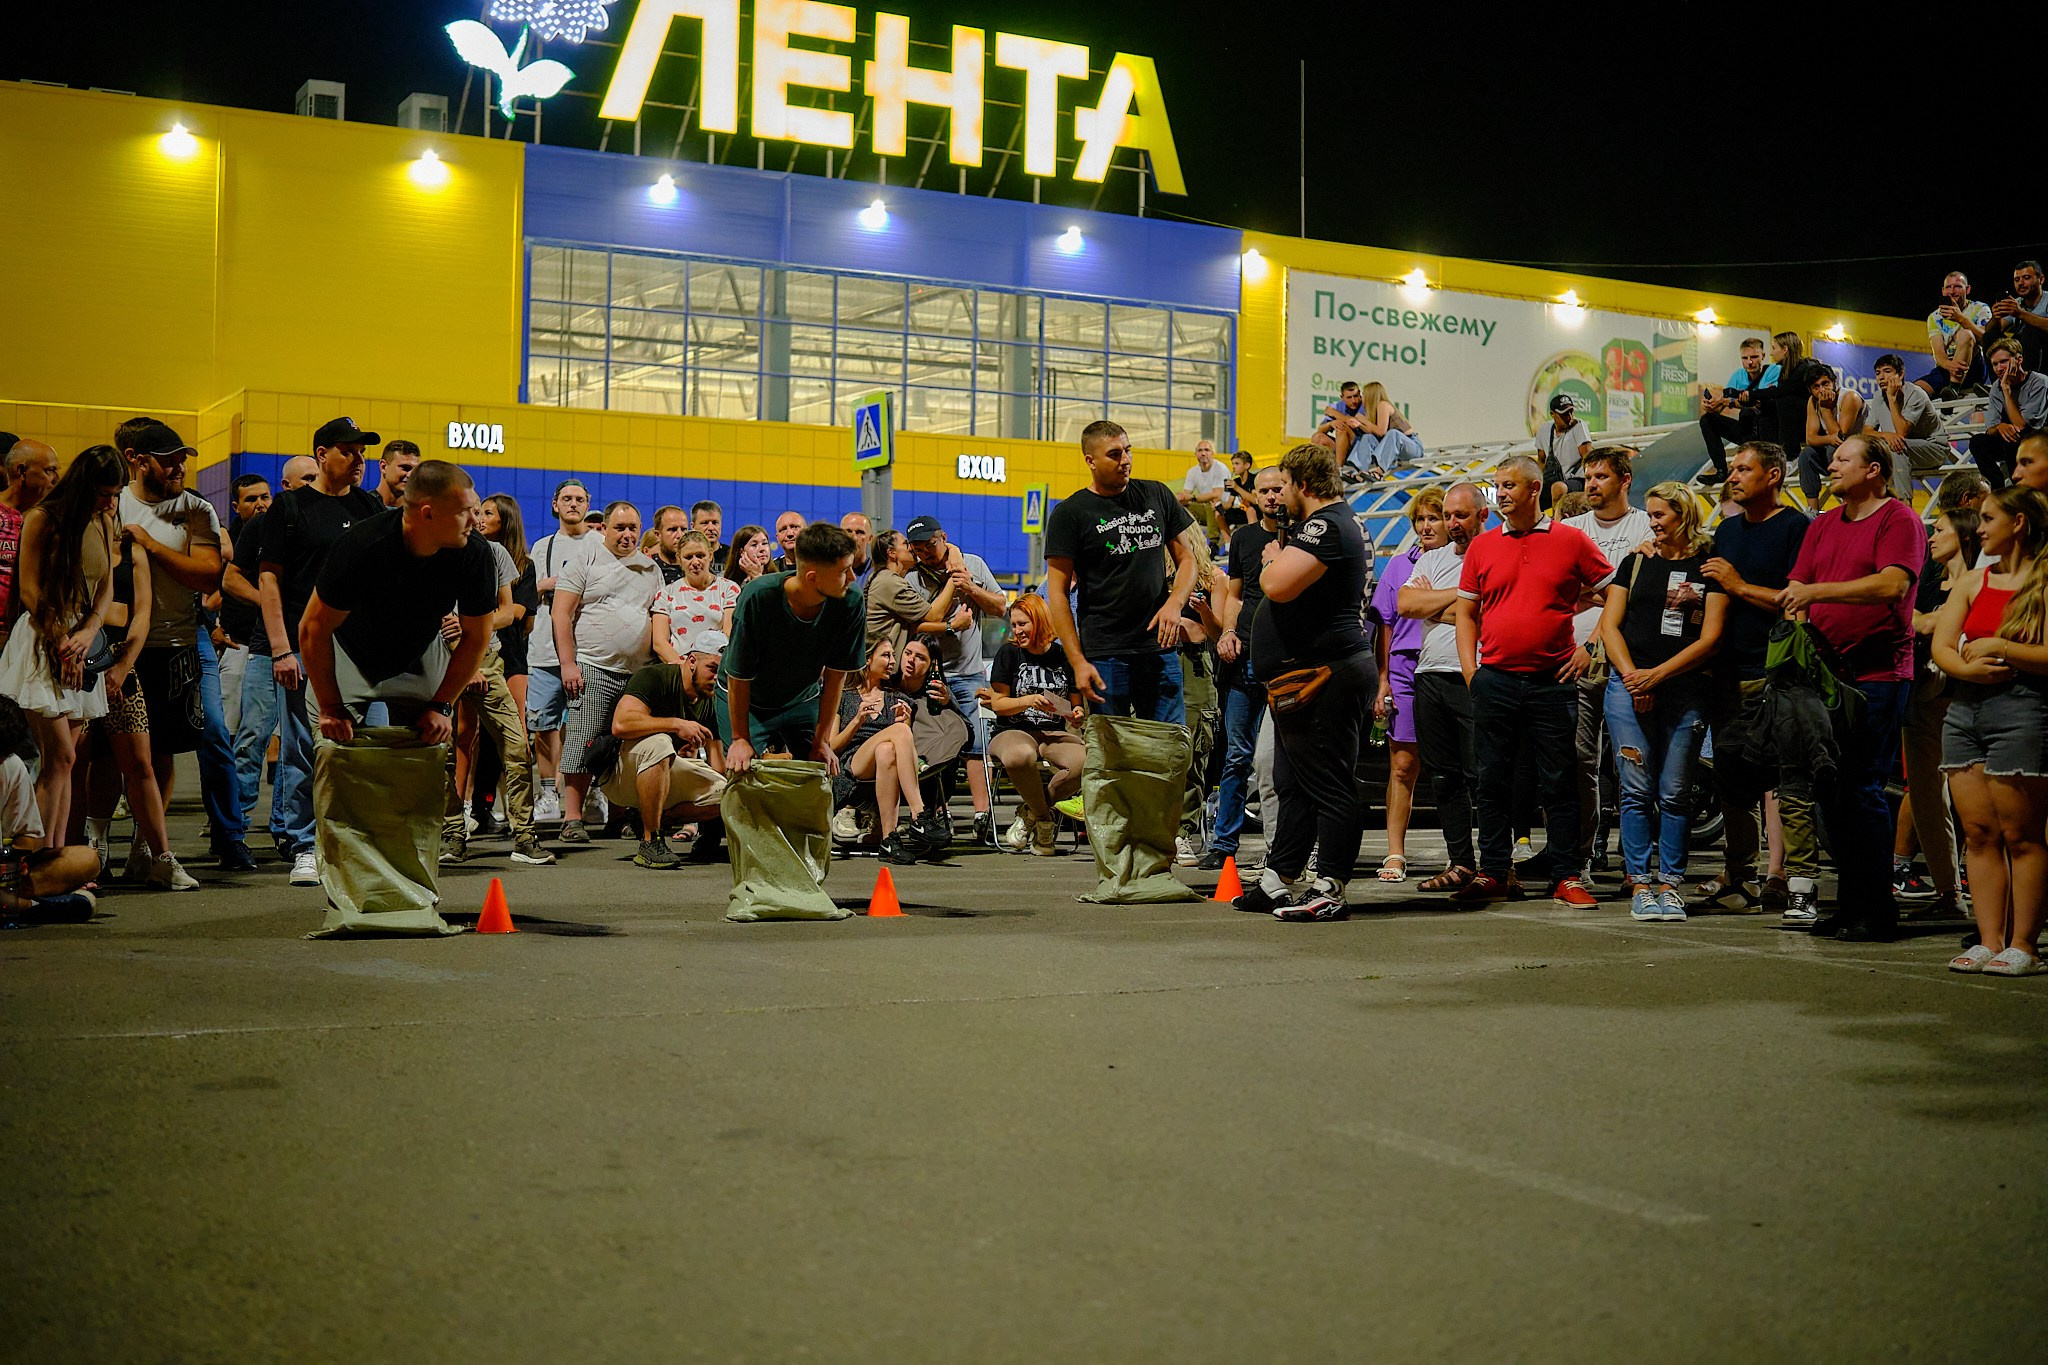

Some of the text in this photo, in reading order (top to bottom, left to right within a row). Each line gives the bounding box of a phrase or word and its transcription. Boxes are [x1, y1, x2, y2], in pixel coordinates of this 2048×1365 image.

[599, 0, 1188, 197] ЛЕНТА
[1314, 290, 1497, 347] По-свежему
[1313, 335, 1427, 367] вкусно!
[1661, 368, 1689, 384] FRESH
[1573, 398, 1592, 413] ESH
[448, 421, 505, 454] ВХОД
[958, 454, 1007, 483] ВХОД
[1118, 525, 1154, 534] ENDURO
